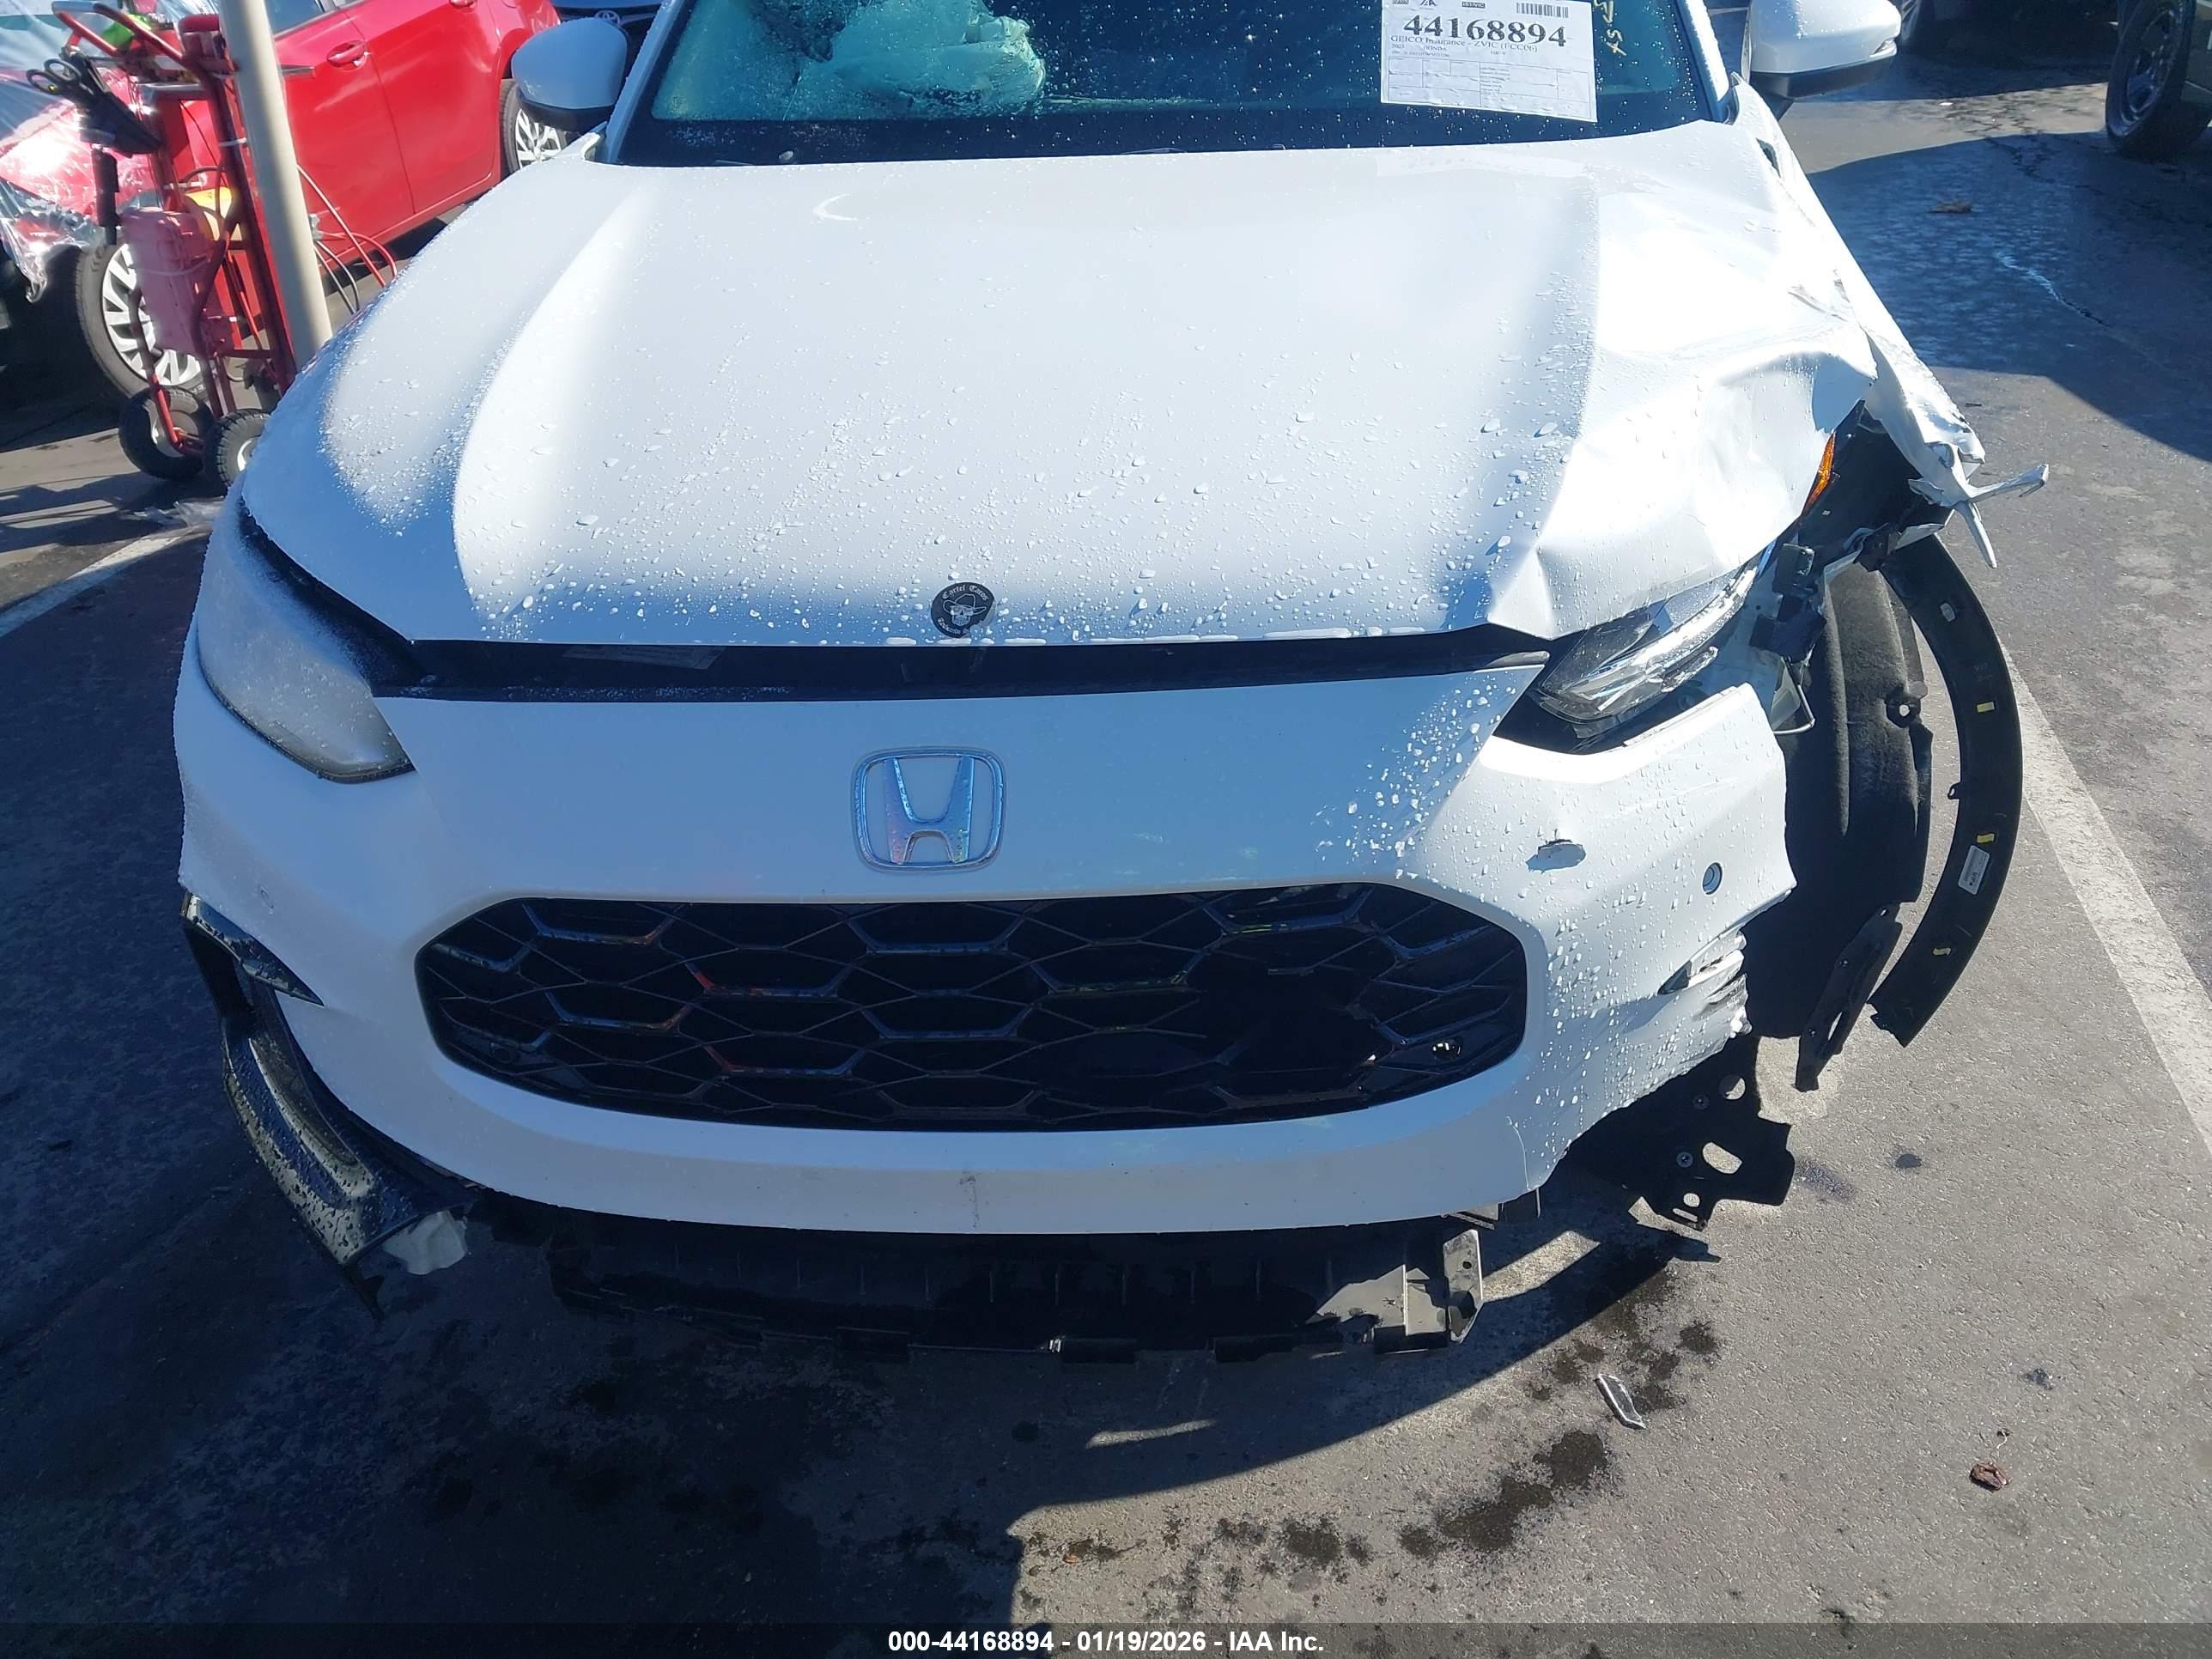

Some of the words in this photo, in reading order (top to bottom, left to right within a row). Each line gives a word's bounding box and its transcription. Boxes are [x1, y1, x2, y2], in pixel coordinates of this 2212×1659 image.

[1403, 15, 1566, 47] 44168894
[1391, 34, 1422, 43] GEICO
[1425, 36, 1465, 46] Insurance
[942, 584, 966, 599] Cartel
[969, 585, 990, 601] Tacos
